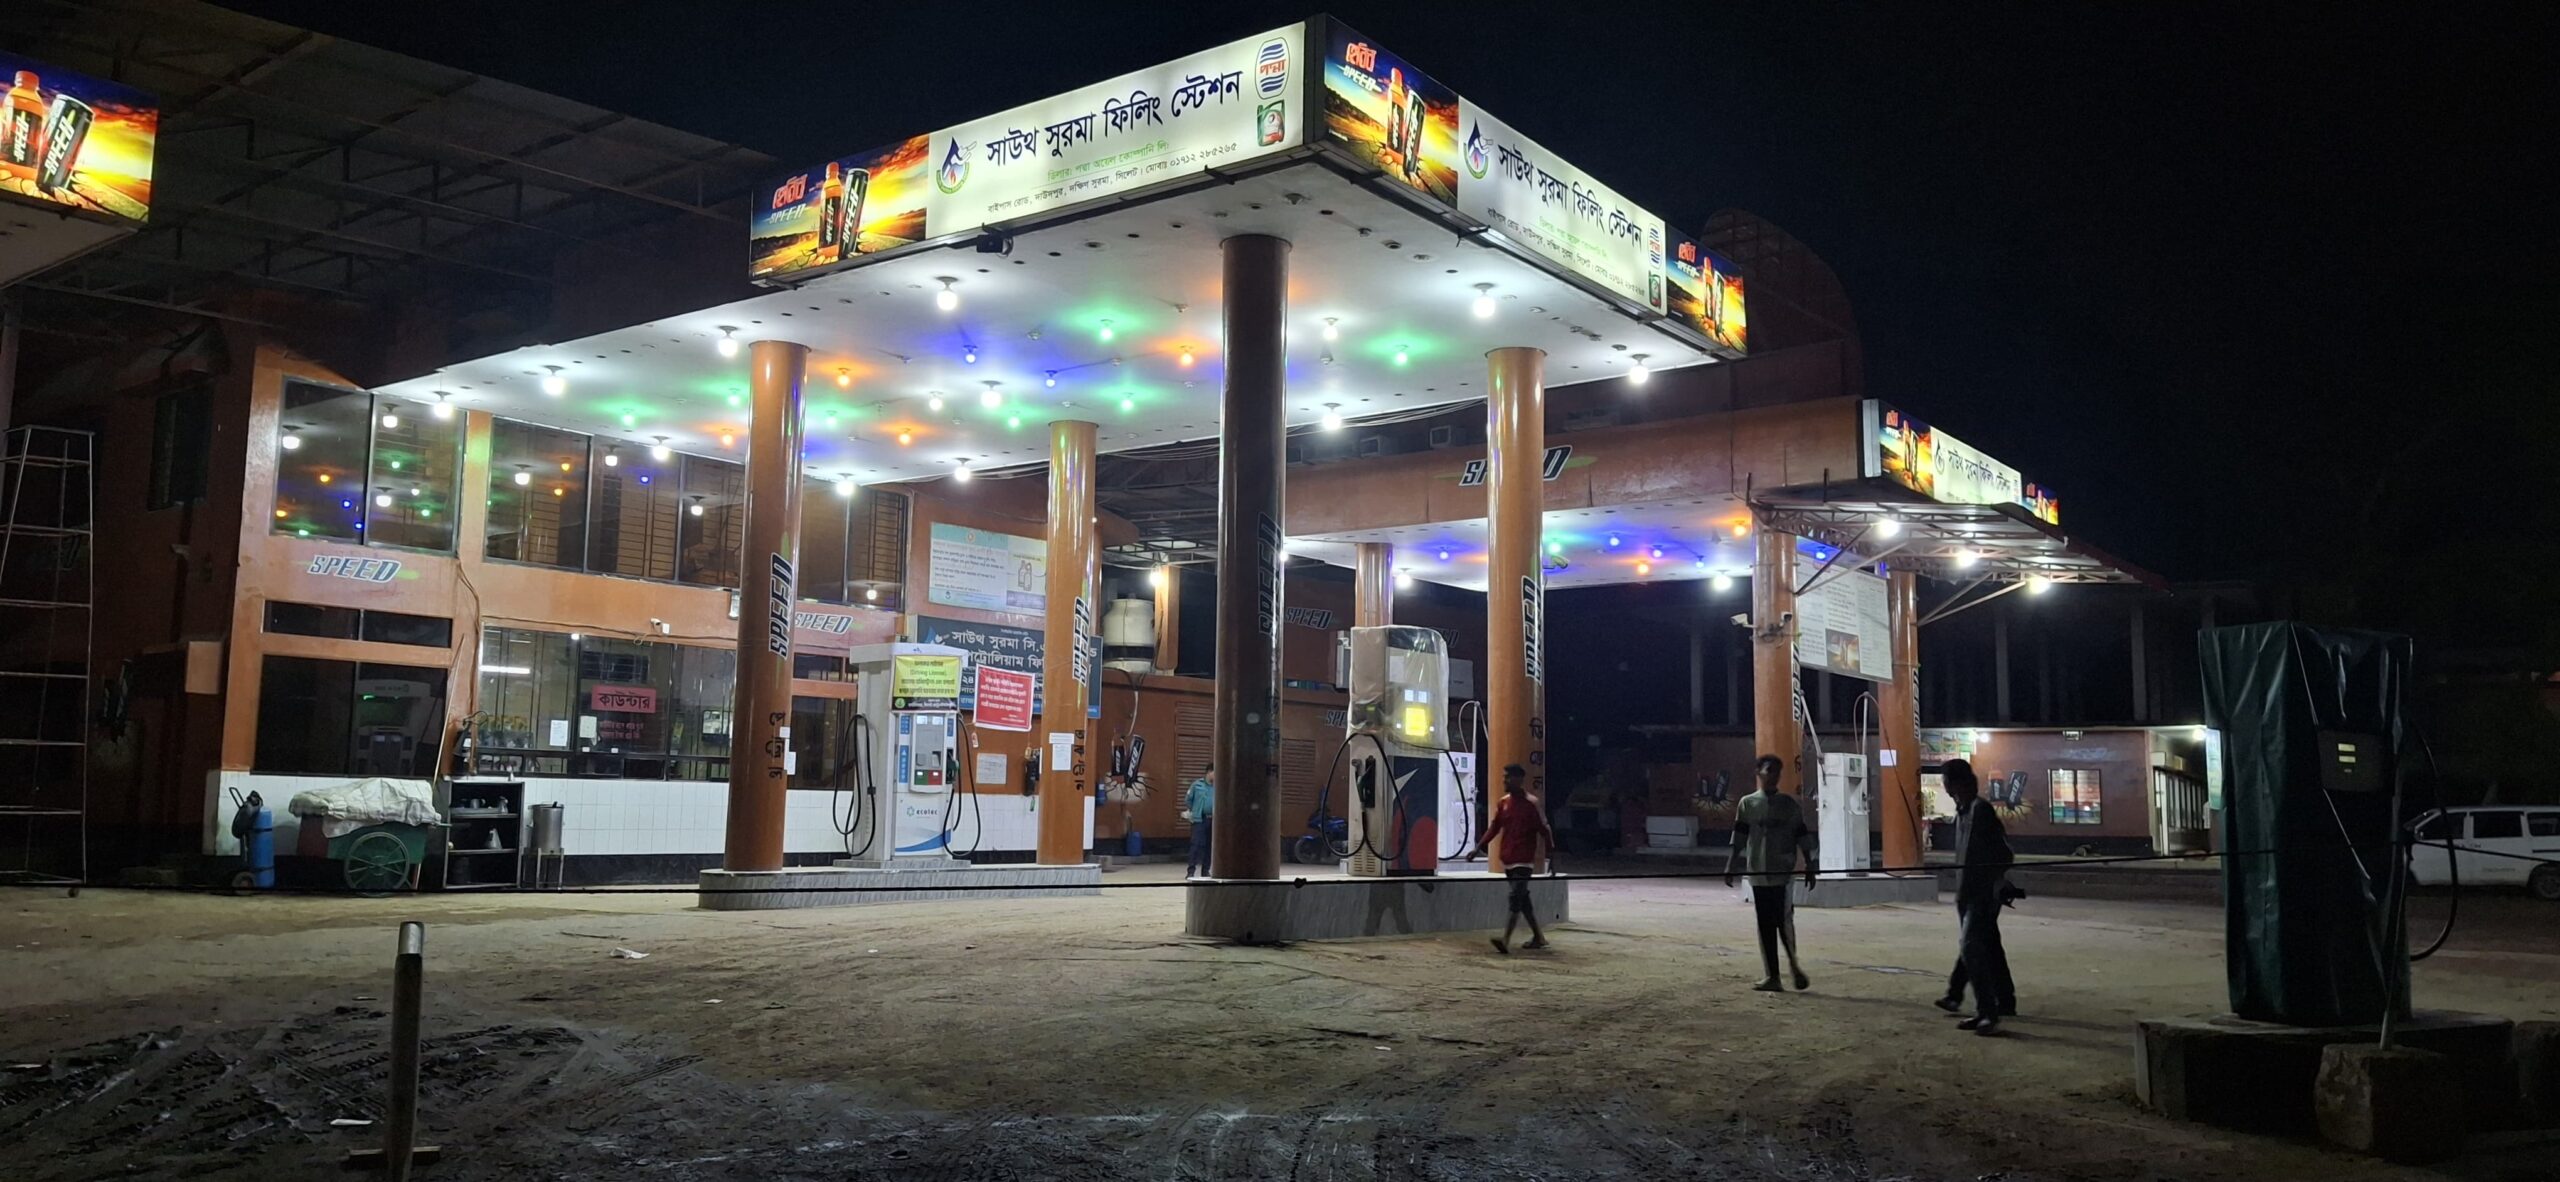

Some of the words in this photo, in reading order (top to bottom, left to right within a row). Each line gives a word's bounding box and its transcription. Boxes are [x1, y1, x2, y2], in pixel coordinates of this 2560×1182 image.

[986, 126, 1040, 166] সাউথ
[1044, 112, 1097, 158] সুরমা
[1103, 90, 1163, 137] ফিলিং
[1171, 71, 1243, 117] স্টেশন
[14, 114, 30, 162] SPEED
[44, 116, 75, 176] SPEED
[988, 200, 1012, 213] বাইপাস
[1498, 143, 1534, 190] সাউথ
[1537, 168, 1569, 210] সুরমা
[1572, 180, 1606, 233] ফিলিং
[1609, 204, 1642, 251] স্টেশন
[307, 555, 401, 583] SPEED
[769, 552, 793, 660] SPEED
[1285, 607, 1332, 630] SPEED
[794, 612, 853, 635] SPEED
[952, 629, 985, 646] সাউথ
[989, 635, 1019, 650] সুরমা
[598, 690, 650, 709] কাউন্টার
